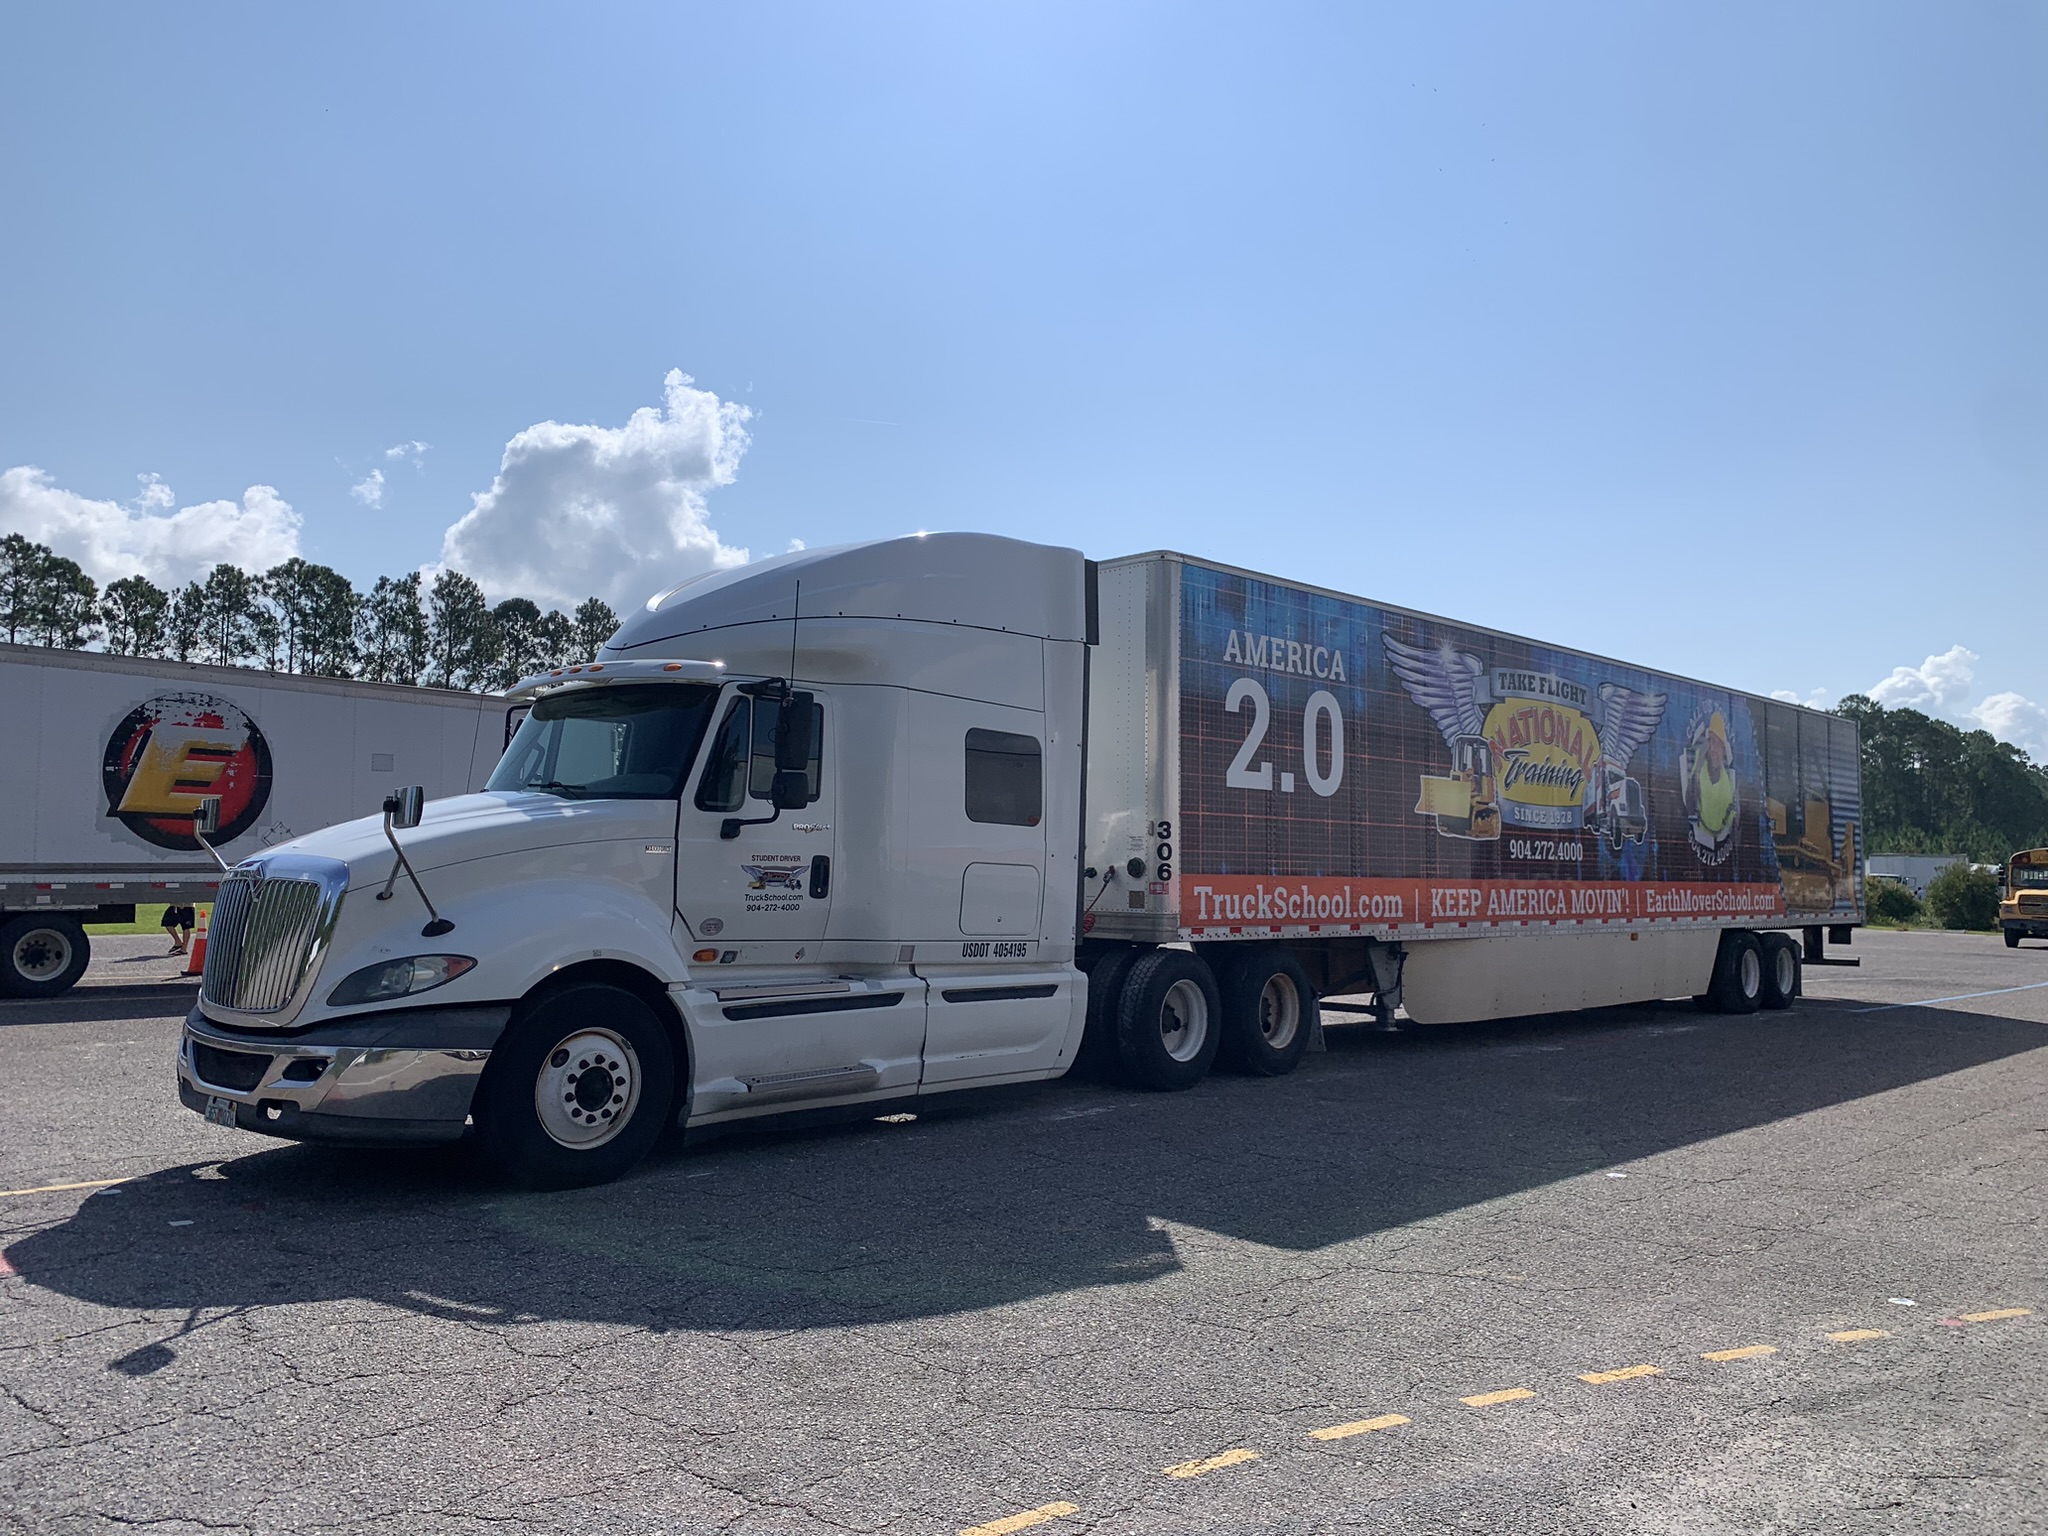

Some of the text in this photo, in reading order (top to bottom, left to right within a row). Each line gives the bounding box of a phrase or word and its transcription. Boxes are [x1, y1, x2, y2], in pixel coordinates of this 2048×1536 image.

[1223, 629, 1346, 682] AMERICA
[1498, 672, 1587, 705] TAKE FLIGHT
[1224, 677, 1344, 797] 2.0
[1488, 706, 1595, 781] NATIONAL
[1503, 748, 1584, 801] Training
[1514, 807, 1547, 823] SINCE
[1509, 839, 1583, 861] 904.272.4000
[744, 893, 804, 901] TruckSchool.com
[746, 903, 800, 912] 904-272-4000
[1193, 884, 1404, 920] TruckSchool.com
[1431, 888, 1482, 917] KEEP
[1487, 888, 1567, 916] AMERICA
[1570, 887, 1630, 915] MOVIN'!
[1645, 887, 1776, 913] EarthMoverSchool.com
[961, 942, 1028, 958] USDOT 4054195
